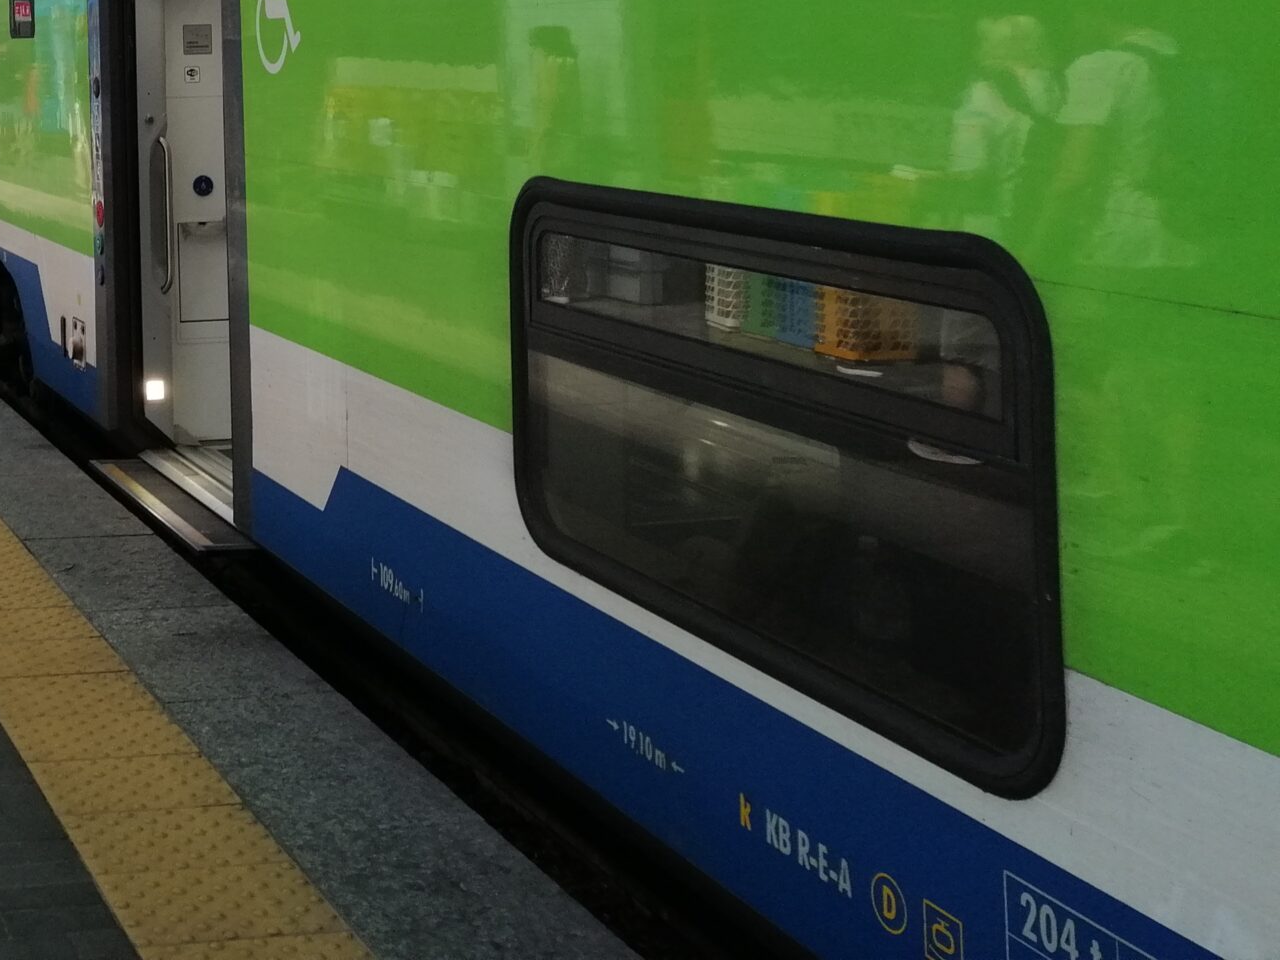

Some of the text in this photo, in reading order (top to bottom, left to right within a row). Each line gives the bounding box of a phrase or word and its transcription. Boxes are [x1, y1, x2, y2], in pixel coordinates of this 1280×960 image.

[765, 808, 792, 856] KB
[797, 828, 853, 899] R-E-A
[882, 884, 897, 920] D
[1019, 891, 1080, 960] 204
